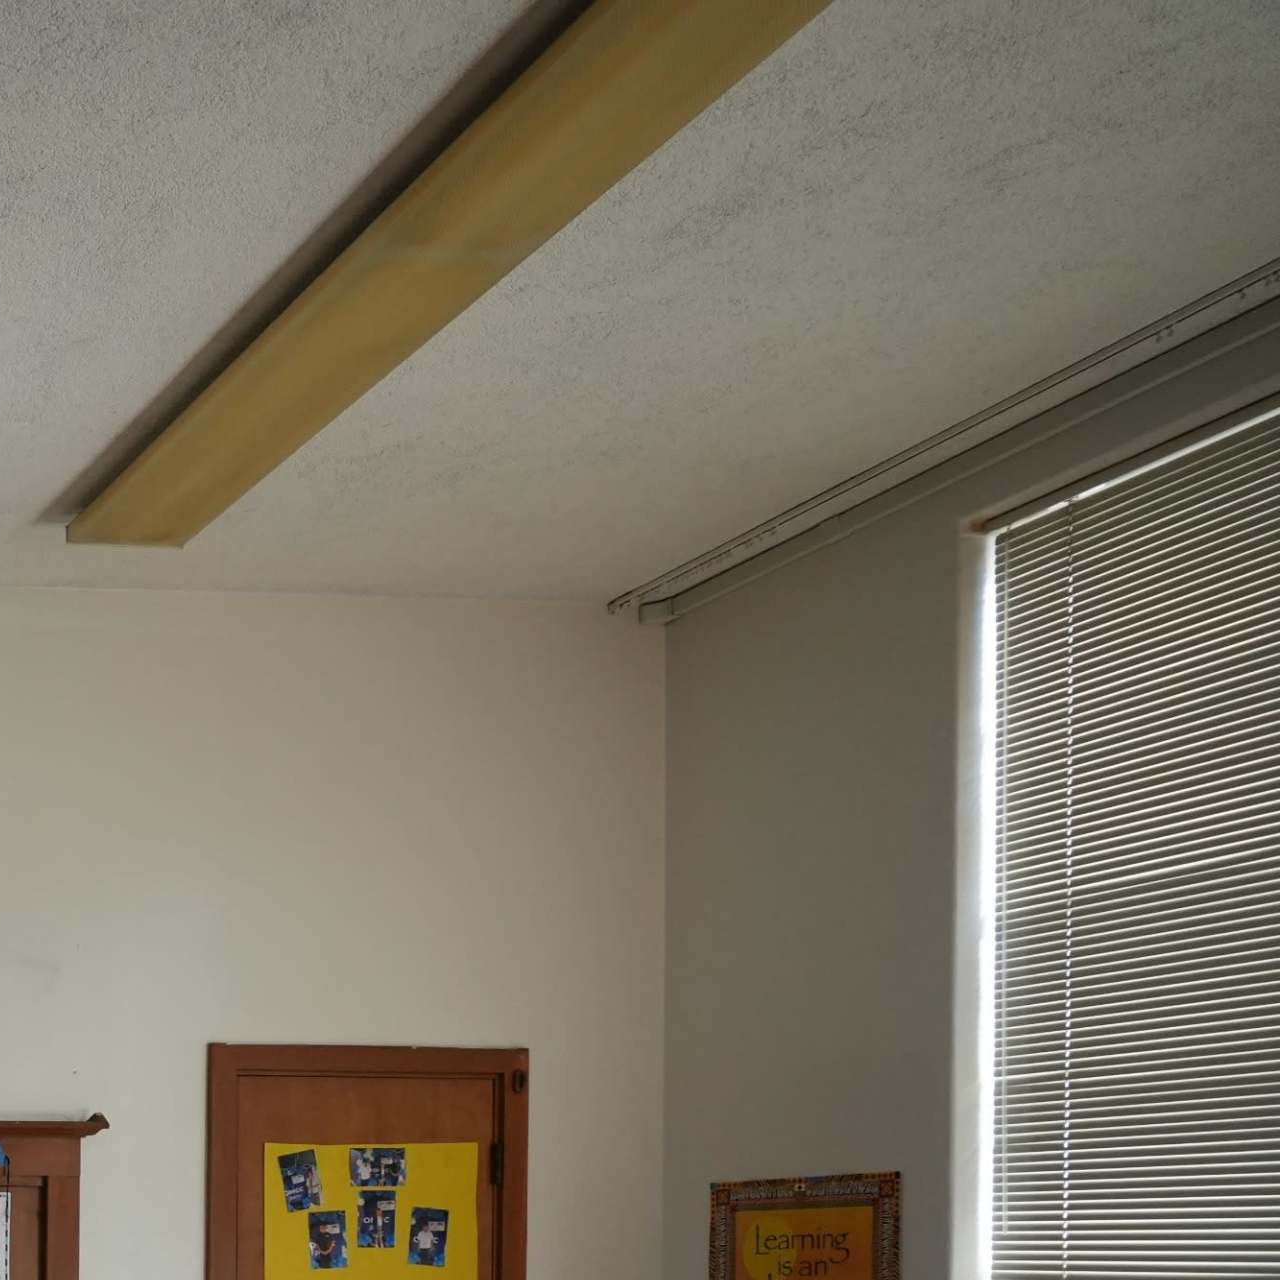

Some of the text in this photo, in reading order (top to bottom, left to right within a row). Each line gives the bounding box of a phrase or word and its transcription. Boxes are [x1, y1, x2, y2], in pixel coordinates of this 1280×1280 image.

[755, 1225, 850, 1264] Learning
[778, 1254, 827, 1277] is an
